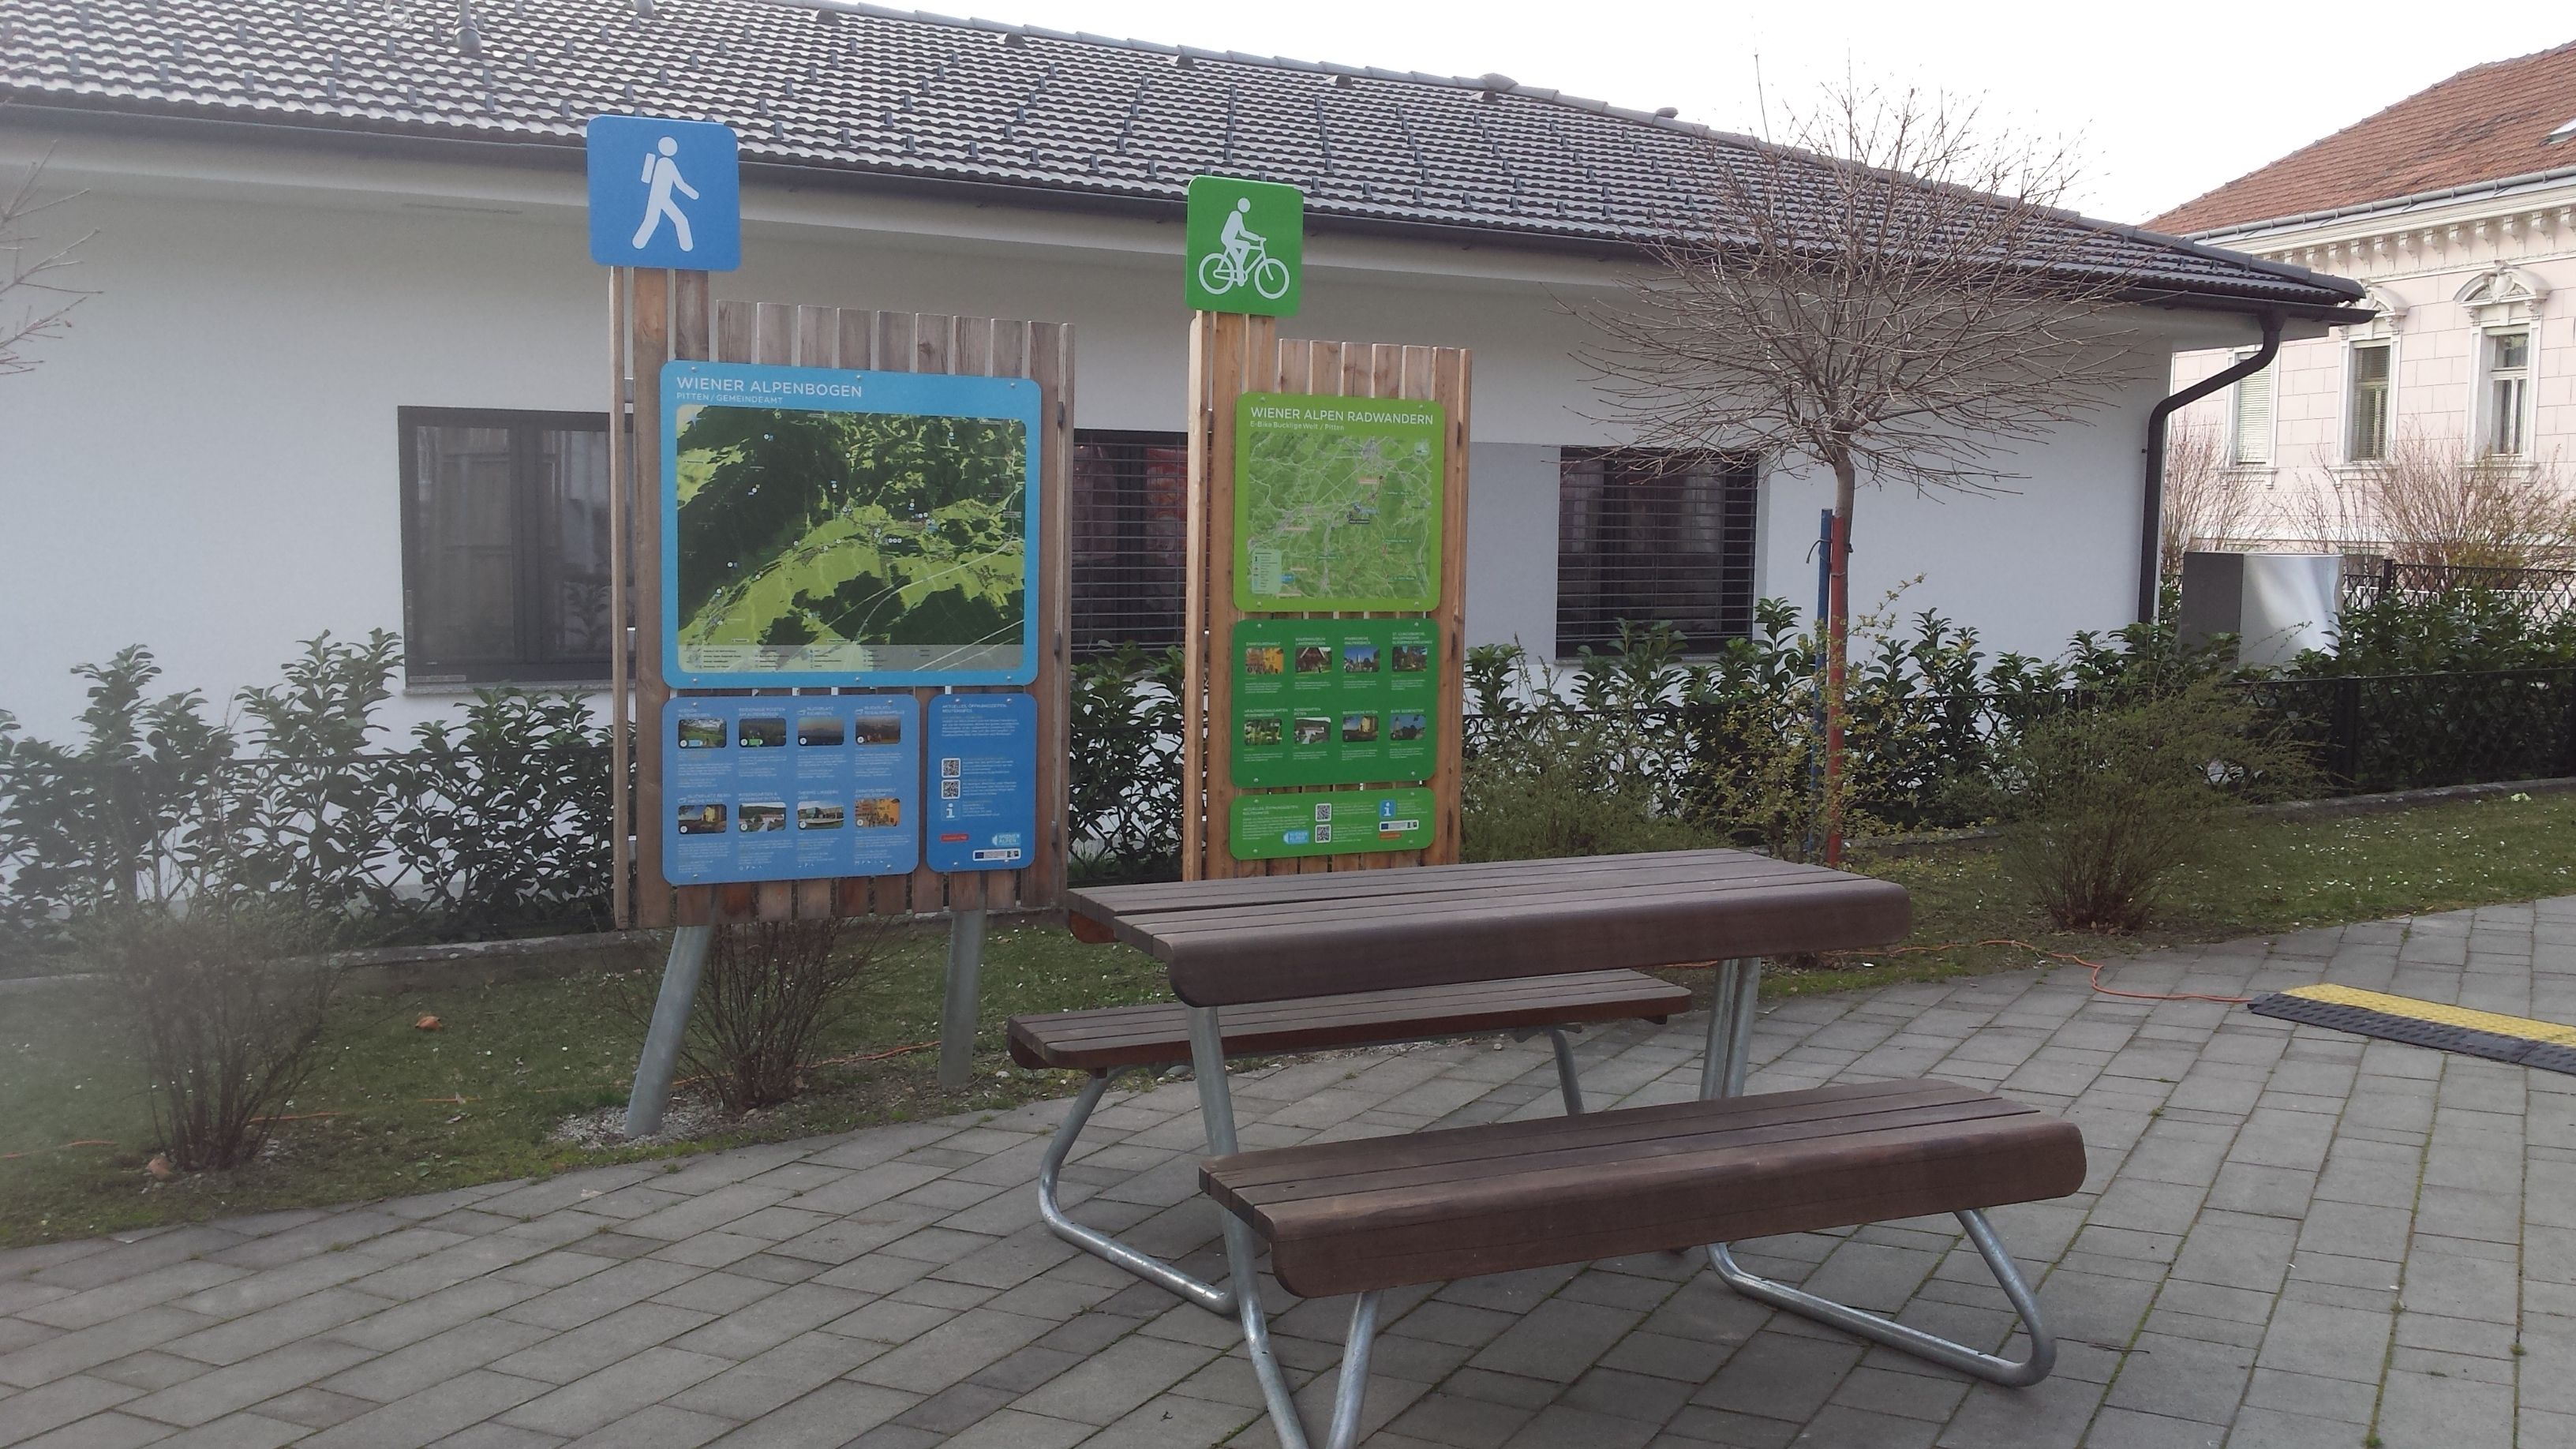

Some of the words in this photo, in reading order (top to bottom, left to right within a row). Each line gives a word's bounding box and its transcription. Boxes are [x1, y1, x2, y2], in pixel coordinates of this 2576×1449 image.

[676, 376, 744, 392] WIENER
[750, 380, 862, 398] ALPENBOGEN
[1250, 406, 1301, 420] WIENER
[1304, 409, 1344, 421] ALPEN
[1347, 411, 1433, 425] RADWANDERN
